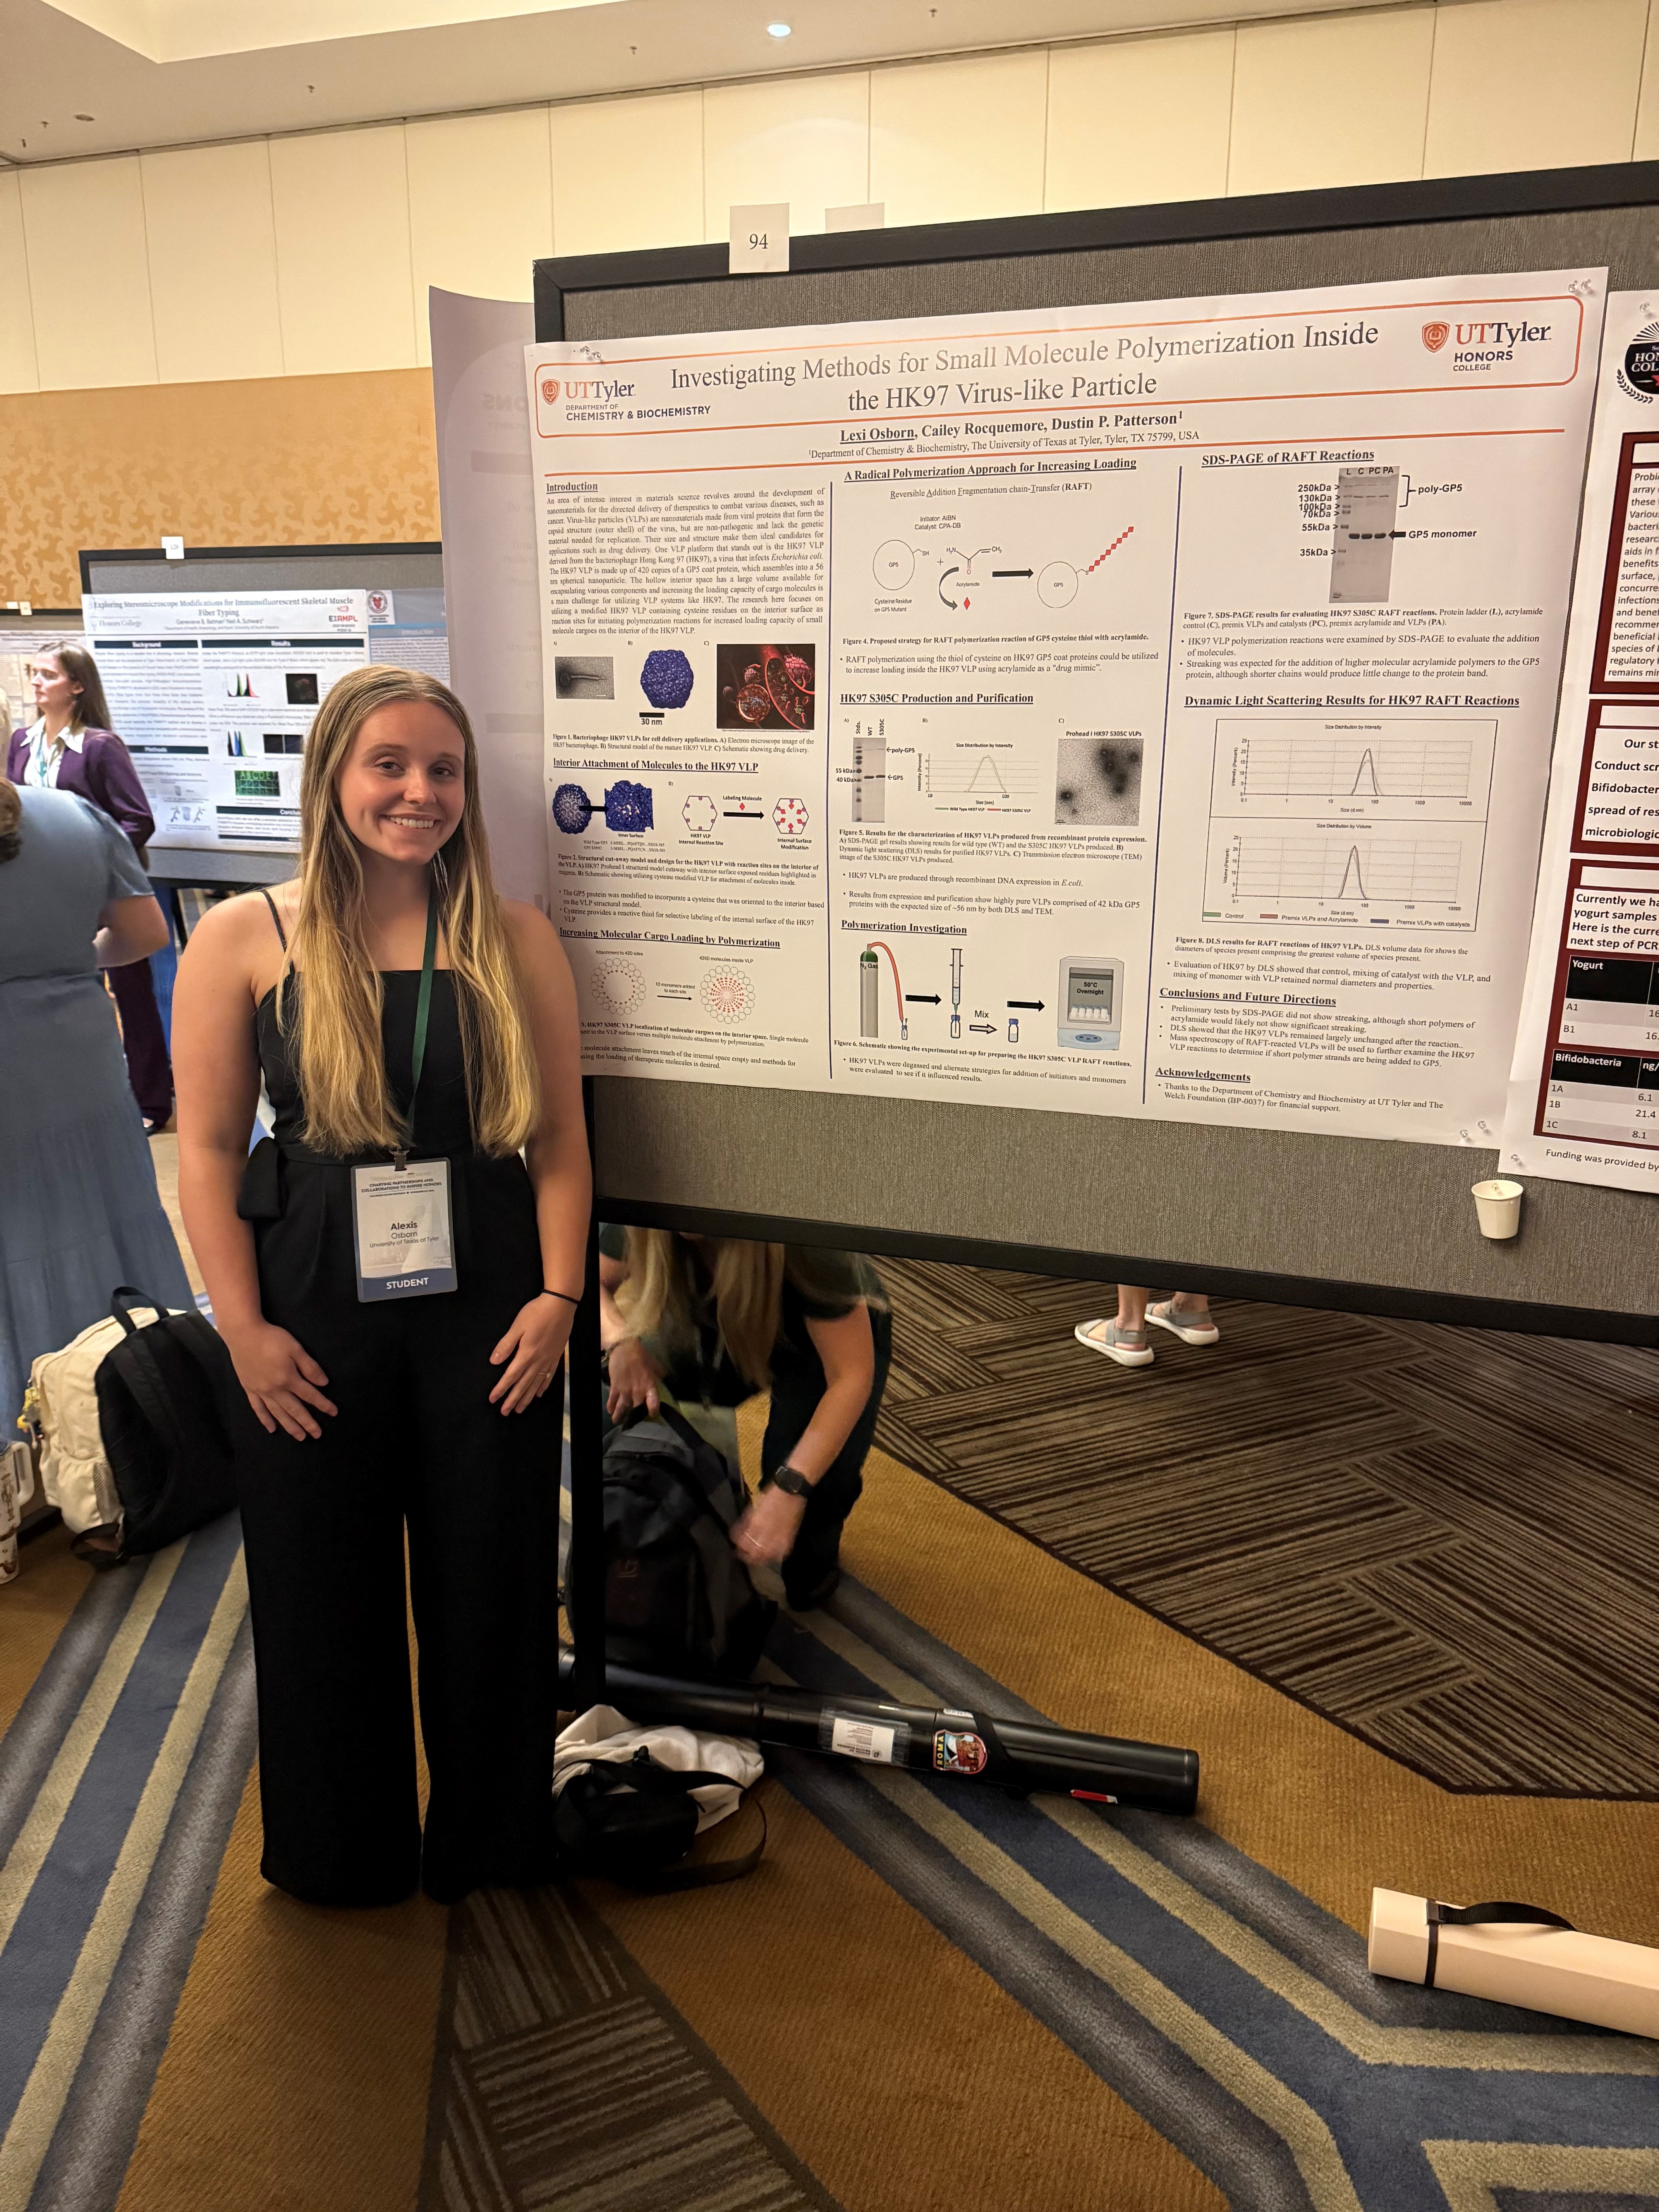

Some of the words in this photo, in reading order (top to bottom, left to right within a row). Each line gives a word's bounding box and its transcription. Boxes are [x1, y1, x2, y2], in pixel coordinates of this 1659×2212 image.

[750, 233, 768, 250] 94
[671, 362, 795, 389] Investigating
[802, 354, 890, 379] Methods
[898, 352, 928, 373] for
[936, 347, 996, 370] Small
[1005, 340, 1108, 366] Molecule
[1117, 328, 1295, 363] Polymerization
[1303, 321, 1378, 347] Inside
[1454, 350, 1513, 362] HONORS
[848, 390, 878, 410] the
[886, 385, 948, 408] HK97
[956, 379, 1063, 404] Virus-like
[1071, 373, 1156, 397] Particle
[567, 411, 623, 421] CHEMISTRY
[628, 411, 633, 419] &
[637, 406, 710, 418] BIOCHEMISTRY
[841, 429, 865, 444] Lexi
[870, 428, 917, 443] Osborn,
[922, 424, 960, 438] Cailey
[965, 422, 1047, 436] Rocquemore,
[1052, 417, 1093, 430] Dustin
[1099, 416, 1109, 427] P.
[856, 448, 865, 456] of
[866, 446, 904, 455] Chemistry
[907, 445, 914, 453] &
[917, 443, 969, 452] Biochemistry,
[972, 441, 986, 450] The
[990, 439, 1030, 449] University
[1033, 438, 1042, 447] of
[1045, 438, 1066, 447] Texas
[1079, 436, 1102, 447] Tyler,
[1105, 434, 1128, 445] Tyler,
[1131, 434, 1144, 442] TX
[1147, 433, 1175, 441] 75799,
[1179, 431, 1199, 440] USA
[1202, 453, 1263, 467] SDS-PAGE
[1267, 452, 1279, 465] of
[1282, 451, 1317, 465] RAFT
[1320, 450, 1374, 463] Reactions
[845, 472, 852, 483] A
[855, 469, 890, 482] Radical
[893, 466, 964, 480] Polymerization
[968, 463, 1016, 477] Approach
[1020, 463, 1034, 474] for
[1038, 460, 1090, 472] Increasing
[1094, 458, 1137, 471] Loading
[547, 482, 597, 493] Introduction
[891, 489, 925, 499] Reversible
[927, 488, 955, 498] Addition
[958, 486, 1007, 496] Fragmentation
[1010, 484, 1060, 493] chain-Transfer
[1062, 483, 1092, 492] (RAFT)
[1418, 484, 1463, 495] poly-GP5
[1614, 632, 1655, 641] beneficial
[1610, 656, 1654, 666] regulatory
[841, 694, 867, 704] HK97
[870, 694, 898, 704] S305C
[902, 694, 952, 705] Production
[956, 694, 973, 704] and
[977, 694, 1033, 704] Purification
[1185, 696, 1231, 708] Dynamic
[1236, 696, 1263, 707] Light
[1267, 696, 1322, 707] Scattering
[1326, 696, 1365, 707] Results
[1369, 696, 1385, 707] for
[1389, 696, 1421, 707] HK97
[1426, 696, 1461, 707] RAFT
[1465, 696, 1519, 708] Reactions
[1625, 739, 1646, 749] Our
[553, 758, 580, 768] Interior
[582, 759, 628, 770] Attachment
[631, 761, 639, 770] of
[642, 761, 682, 771] Molecules
[685, 763, 692, 771] to
[696, 762, 708, 771] the
[711, 763, 735, 772] HK97
[739, 763, 758, 772] VLP
[1595, 761, 1640, 771] Conduct
[1588, 806, 1626, 816] spread
[1629, 807, 1641, 816] of
[1576, 894, 1626, 907] Currently
[1575, 909, 1609, 919] yogurt
[1612, 912, 1657, 922] samples
[842, 920, 906, 933] Polymerization
[910, 924, 966, 936] Investigation
[1572, 922, 1598, 932] Here
[1601, 924, 1609, 933] is
[1613, 924, 1630, 934] the
[560, 928, 598, 939] Increasing
[601, 930, 642, 940] Molecular
[645, 933, 668, 942] Cargo
[672, 933, 703, 944] Loading
[706, 936, 715, 945] by
[719, 936, 780, 949] Polymerization
[1570, 938, 1594, 946] next
[1597, 939, 1620, 950] step
[1623, 940, 1635, 948] of
[1573, 960, 1604, 970] Yogurt
[1159, 988, 1219, 1001] Conclusions
[1223, 992, 1241, 1002] and
[1246, 992, 1279, 1004] Future
[1284, 994, 1336, 1007] Directions
[975, 1010, 989, 1019] Mix
[1556, 1053, 1621, 1067] Bifidobacteria
[1155, 1068, 1250, 1083] Acknowledgements
[1188, 1093, 1225, 1102] Foundation
[1228, 1097, 1264, 1106] (BP-0037)
[1279, 1099, 1309, 1109] financial
[1635, 1110, 1656, 1118] 21.4
[1632, 1131, 1646, 1139] 8.1
[1546, 1149, 1582, 1162] Funding
[1605, 1159, 1645, 1169] provided
[1649, 1163, 1659, 1171] by
[391, 1221, 417, 1230] Alexis
[386, 1278, 429, 1289] STUDENT
